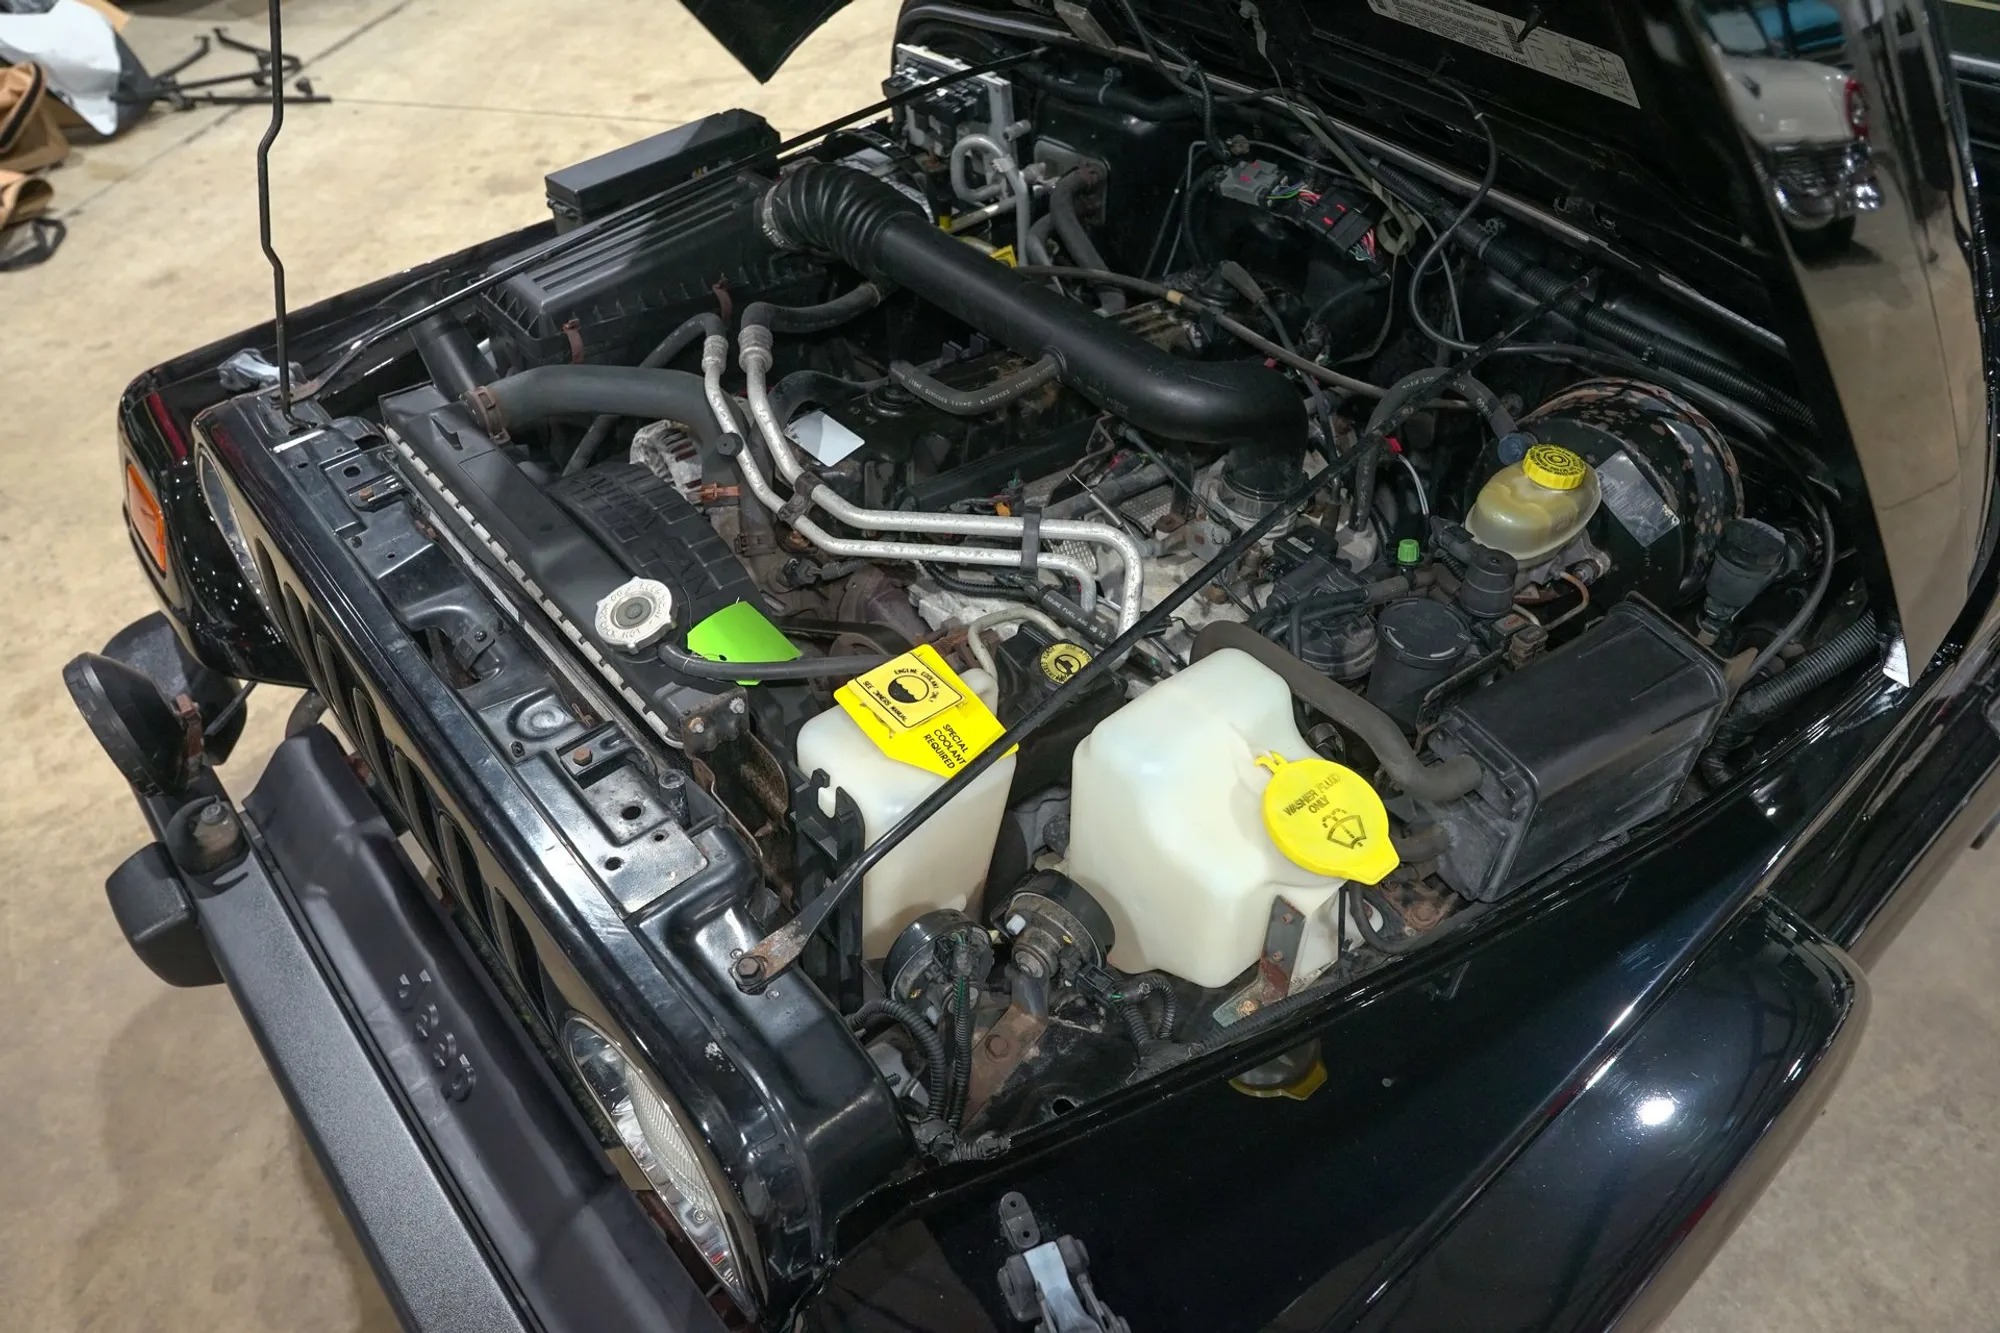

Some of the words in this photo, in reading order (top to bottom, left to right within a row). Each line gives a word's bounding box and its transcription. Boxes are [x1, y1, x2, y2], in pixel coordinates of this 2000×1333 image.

[895, 667, 918, 675] ENGINE
[920, 671, 940, 690] COOLANT
[863, 680, 874, 690] SEE
[889, 704, 908, 722] MANUAL
[923, 734, 956, 770] REQUIRED
[933, 729, 967, 765] COOLANT
[942, 723, 969, 754] SPECIAL
[1283, 790, 1318, 816] WASHER
[1317, 773, 1341, 794] FLUID
[1308, 795, 1330, 814] ONLY
